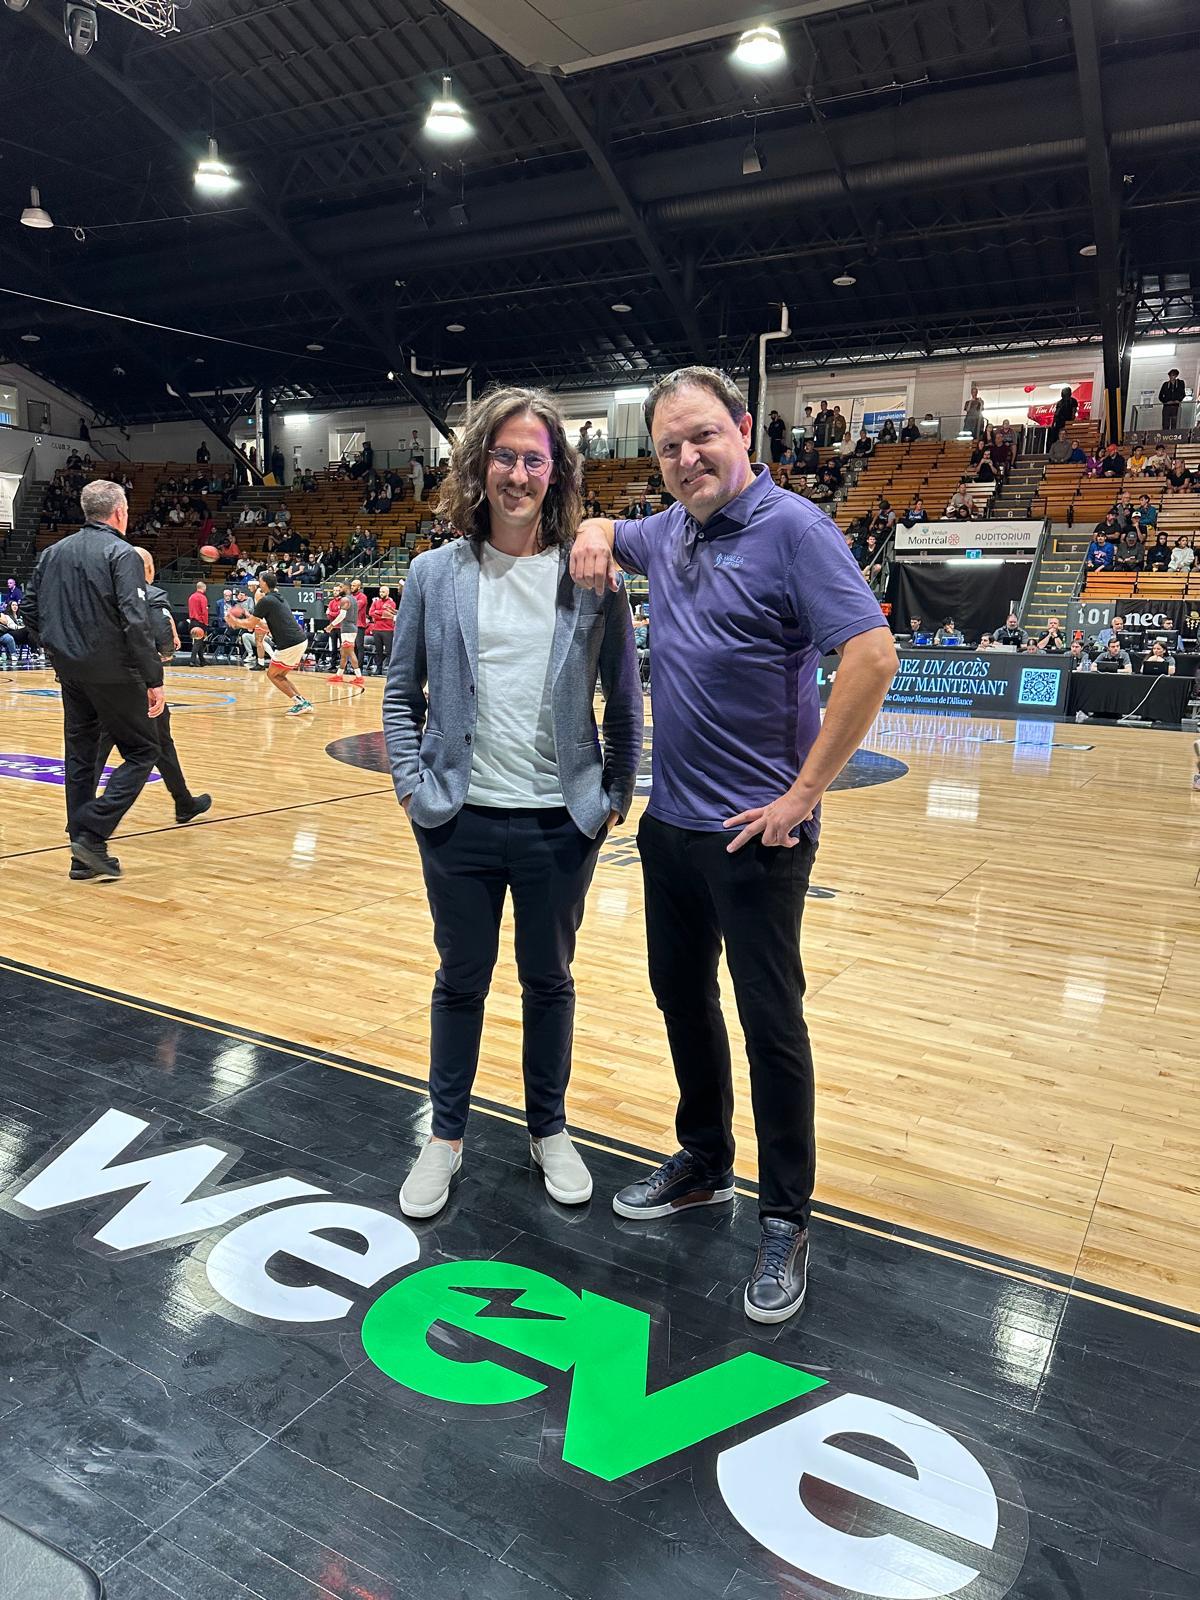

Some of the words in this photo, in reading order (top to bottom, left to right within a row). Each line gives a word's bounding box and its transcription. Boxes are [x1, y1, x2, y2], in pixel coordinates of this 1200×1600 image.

[908, 534, 947, 545] Montréal
[975, 532, 1031, 541] AUDITORIUM
[1056, 585, 1062, 593] C
[298, 591, 315, 603] 123
[1078, 608, 1110, 625] 101
[922, 659, 946, 676] UN
[944, 656, 991, 677] ACCÈS
[915, 677, 1008, 696] MAINTENANT
[893, 693, 915, 704] Chaque
[915, 694, 938, 704] Moment
[938, 695, 946, 704] de
